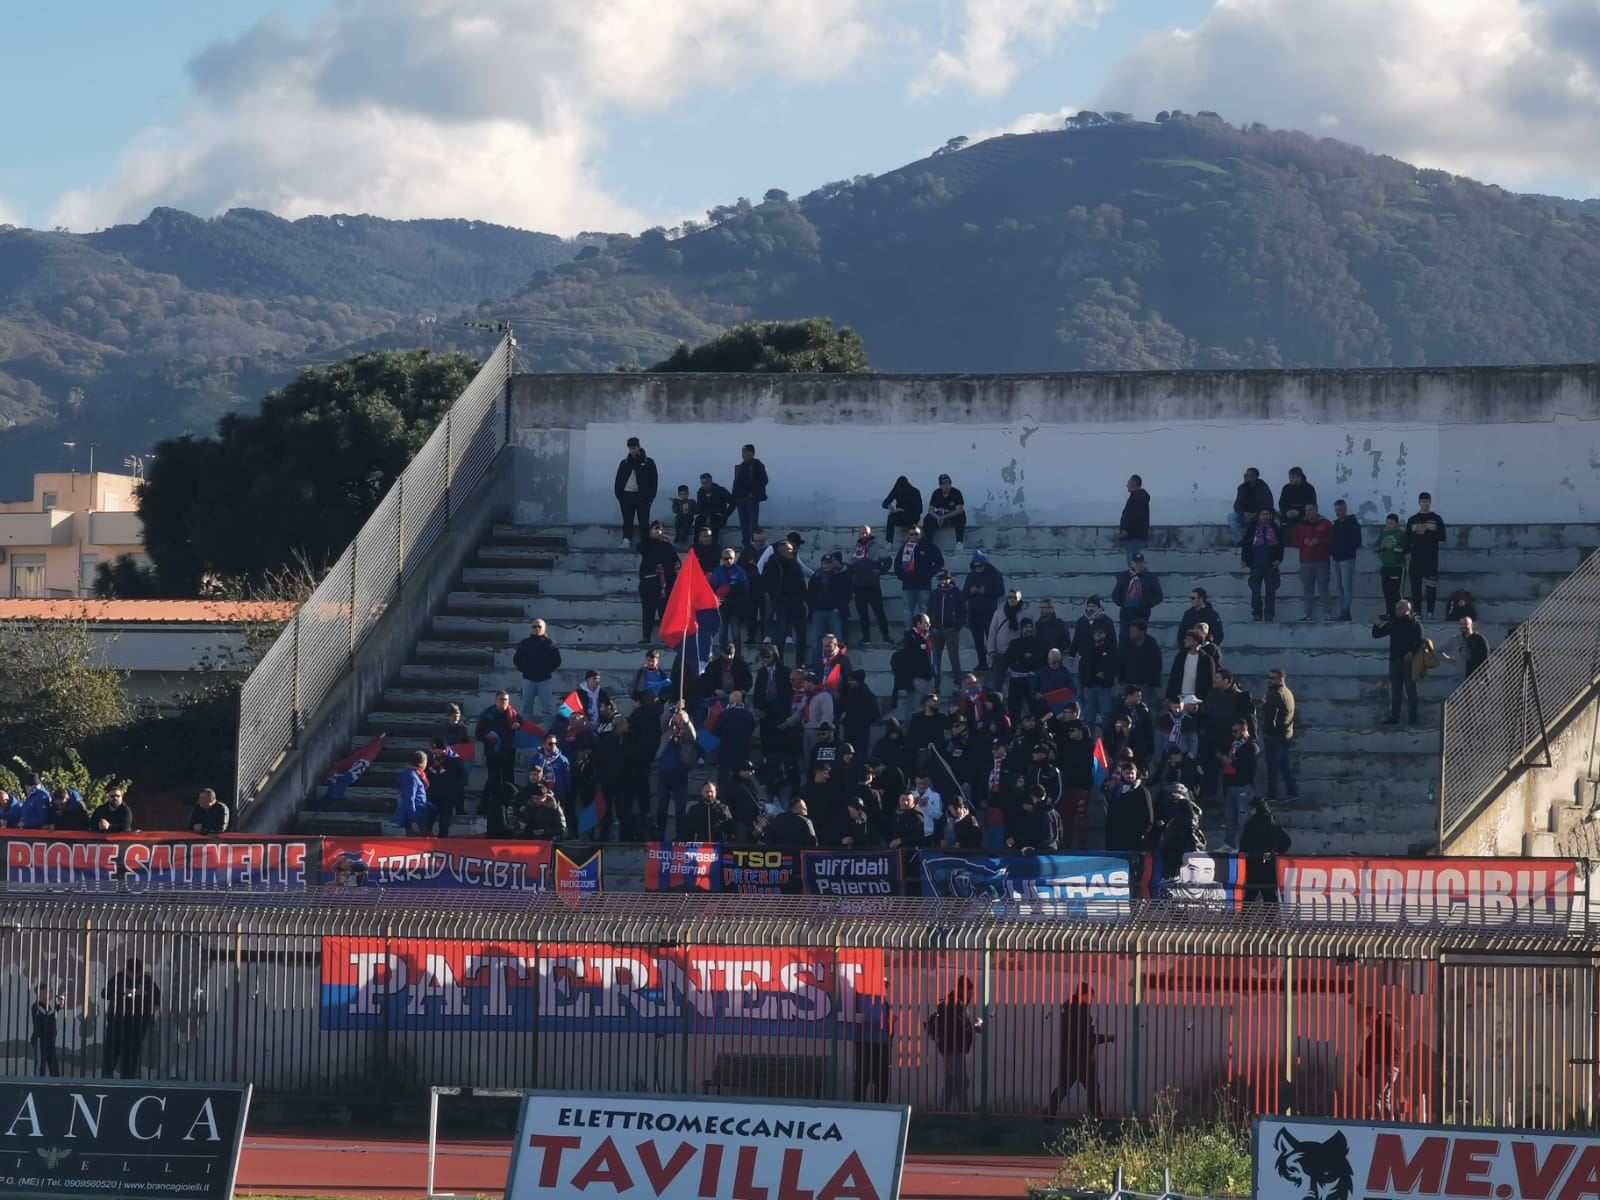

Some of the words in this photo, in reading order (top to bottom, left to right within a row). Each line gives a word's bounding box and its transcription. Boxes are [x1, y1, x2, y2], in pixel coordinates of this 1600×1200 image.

[7, 842, 118, 892] RIONE
[124, 843, 307, 893] SALINELLE
[377, 851, 548, 892] IRRIDUCIBILI
[732, 851, 782, 868] TSO
[815, 858, 888, 876] diffidati
[815, 879, 891, 895] Paternò
[1281, 866, 1571, 925] IRRIDUCIBILI
[349, 953, 864, 1023] PATERNESI
[558, 1108, 843, 1142] ELETTROMECCANICA
[18, 1177, 40, 1187] (ME)
[47, 1178, 61, 1187] Tel.
[124, 1182, 210, 1192] www.brancagioielli.it
[529, 1134, 880, 1200] TAVILLA
